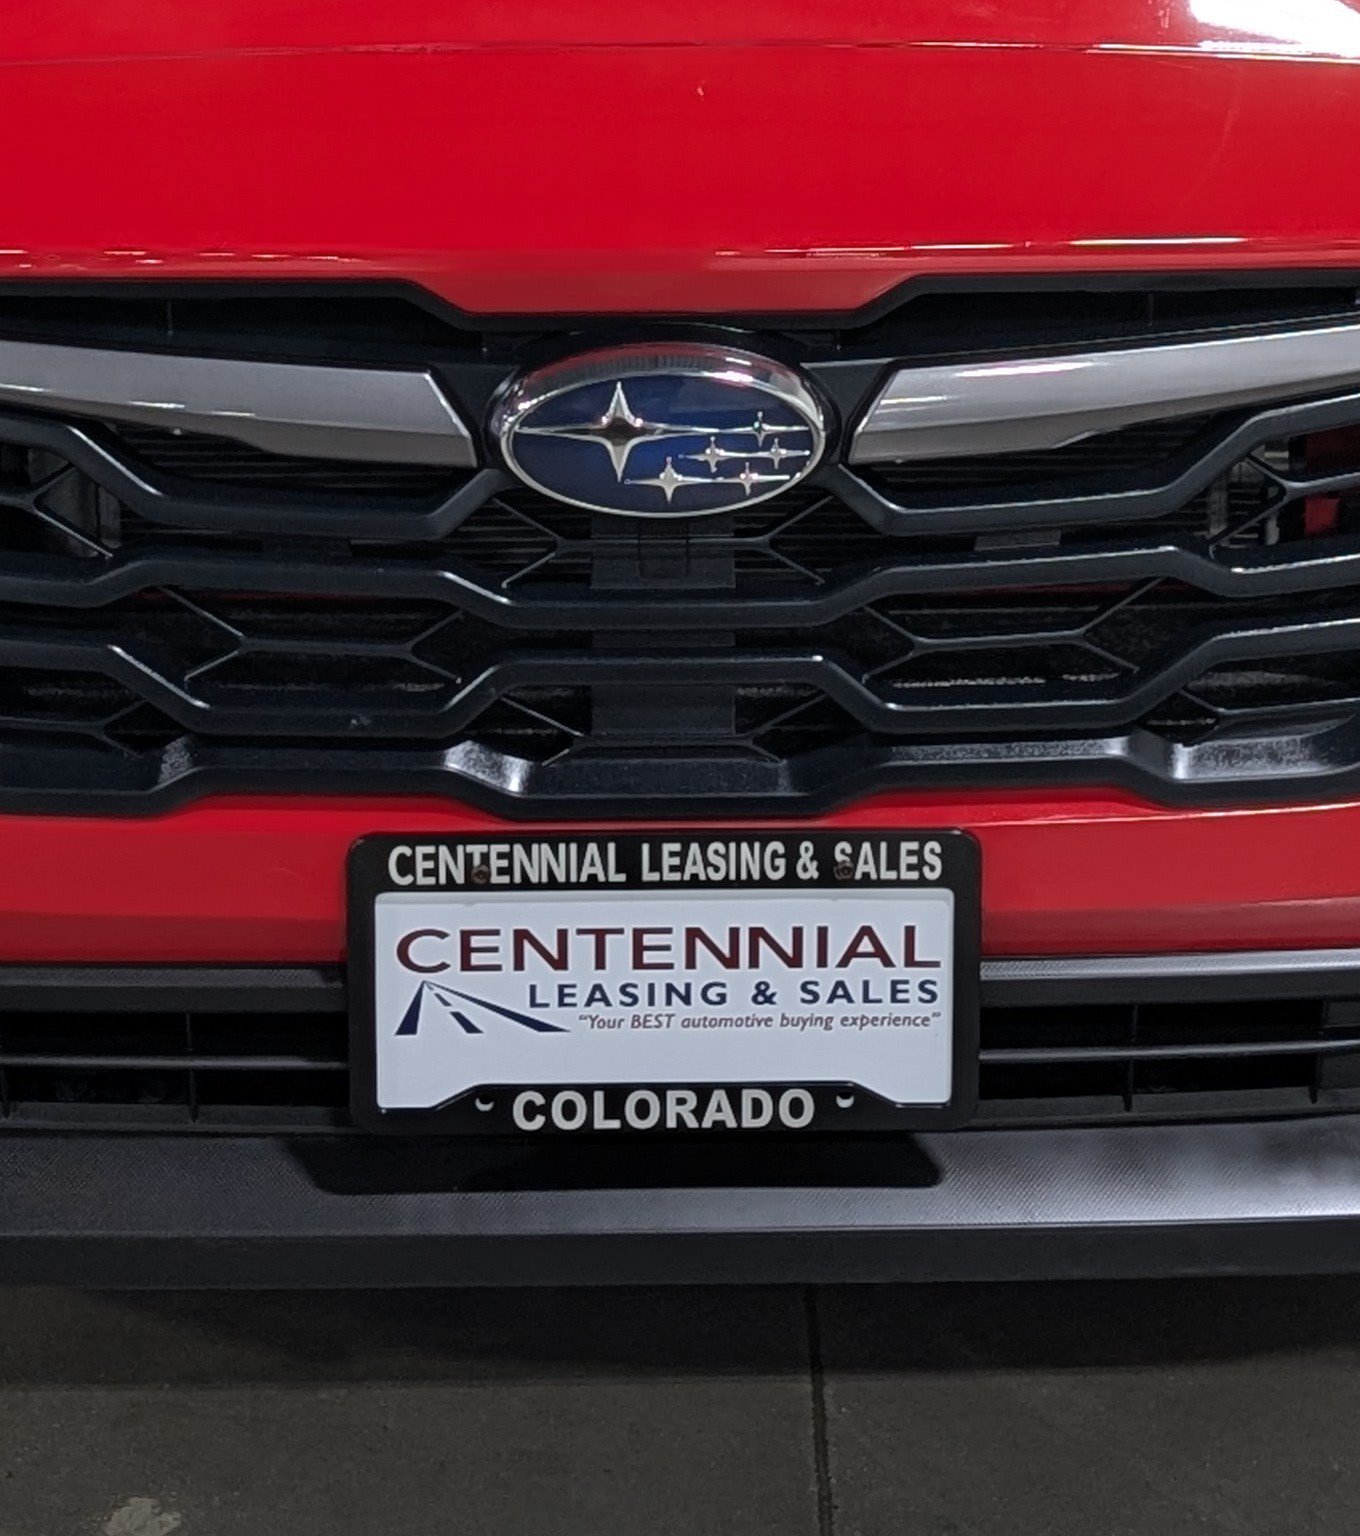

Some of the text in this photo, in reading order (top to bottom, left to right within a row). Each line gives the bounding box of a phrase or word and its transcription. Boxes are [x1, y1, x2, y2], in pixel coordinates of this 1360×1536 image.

[388, 840, 942, 886] CENTENNIAL LEASING & SALES
[396, 924, 942, 973] CENTENNIAL
[529, 978, 939, 1009] LEASING & SALES
[630, 1013, 676, 1030] BEST
[680, 1013, 774, 1030] automotive
[779, 1012, 835, 1032] buying
[512, 1088, 815, 1132] COLORADO
